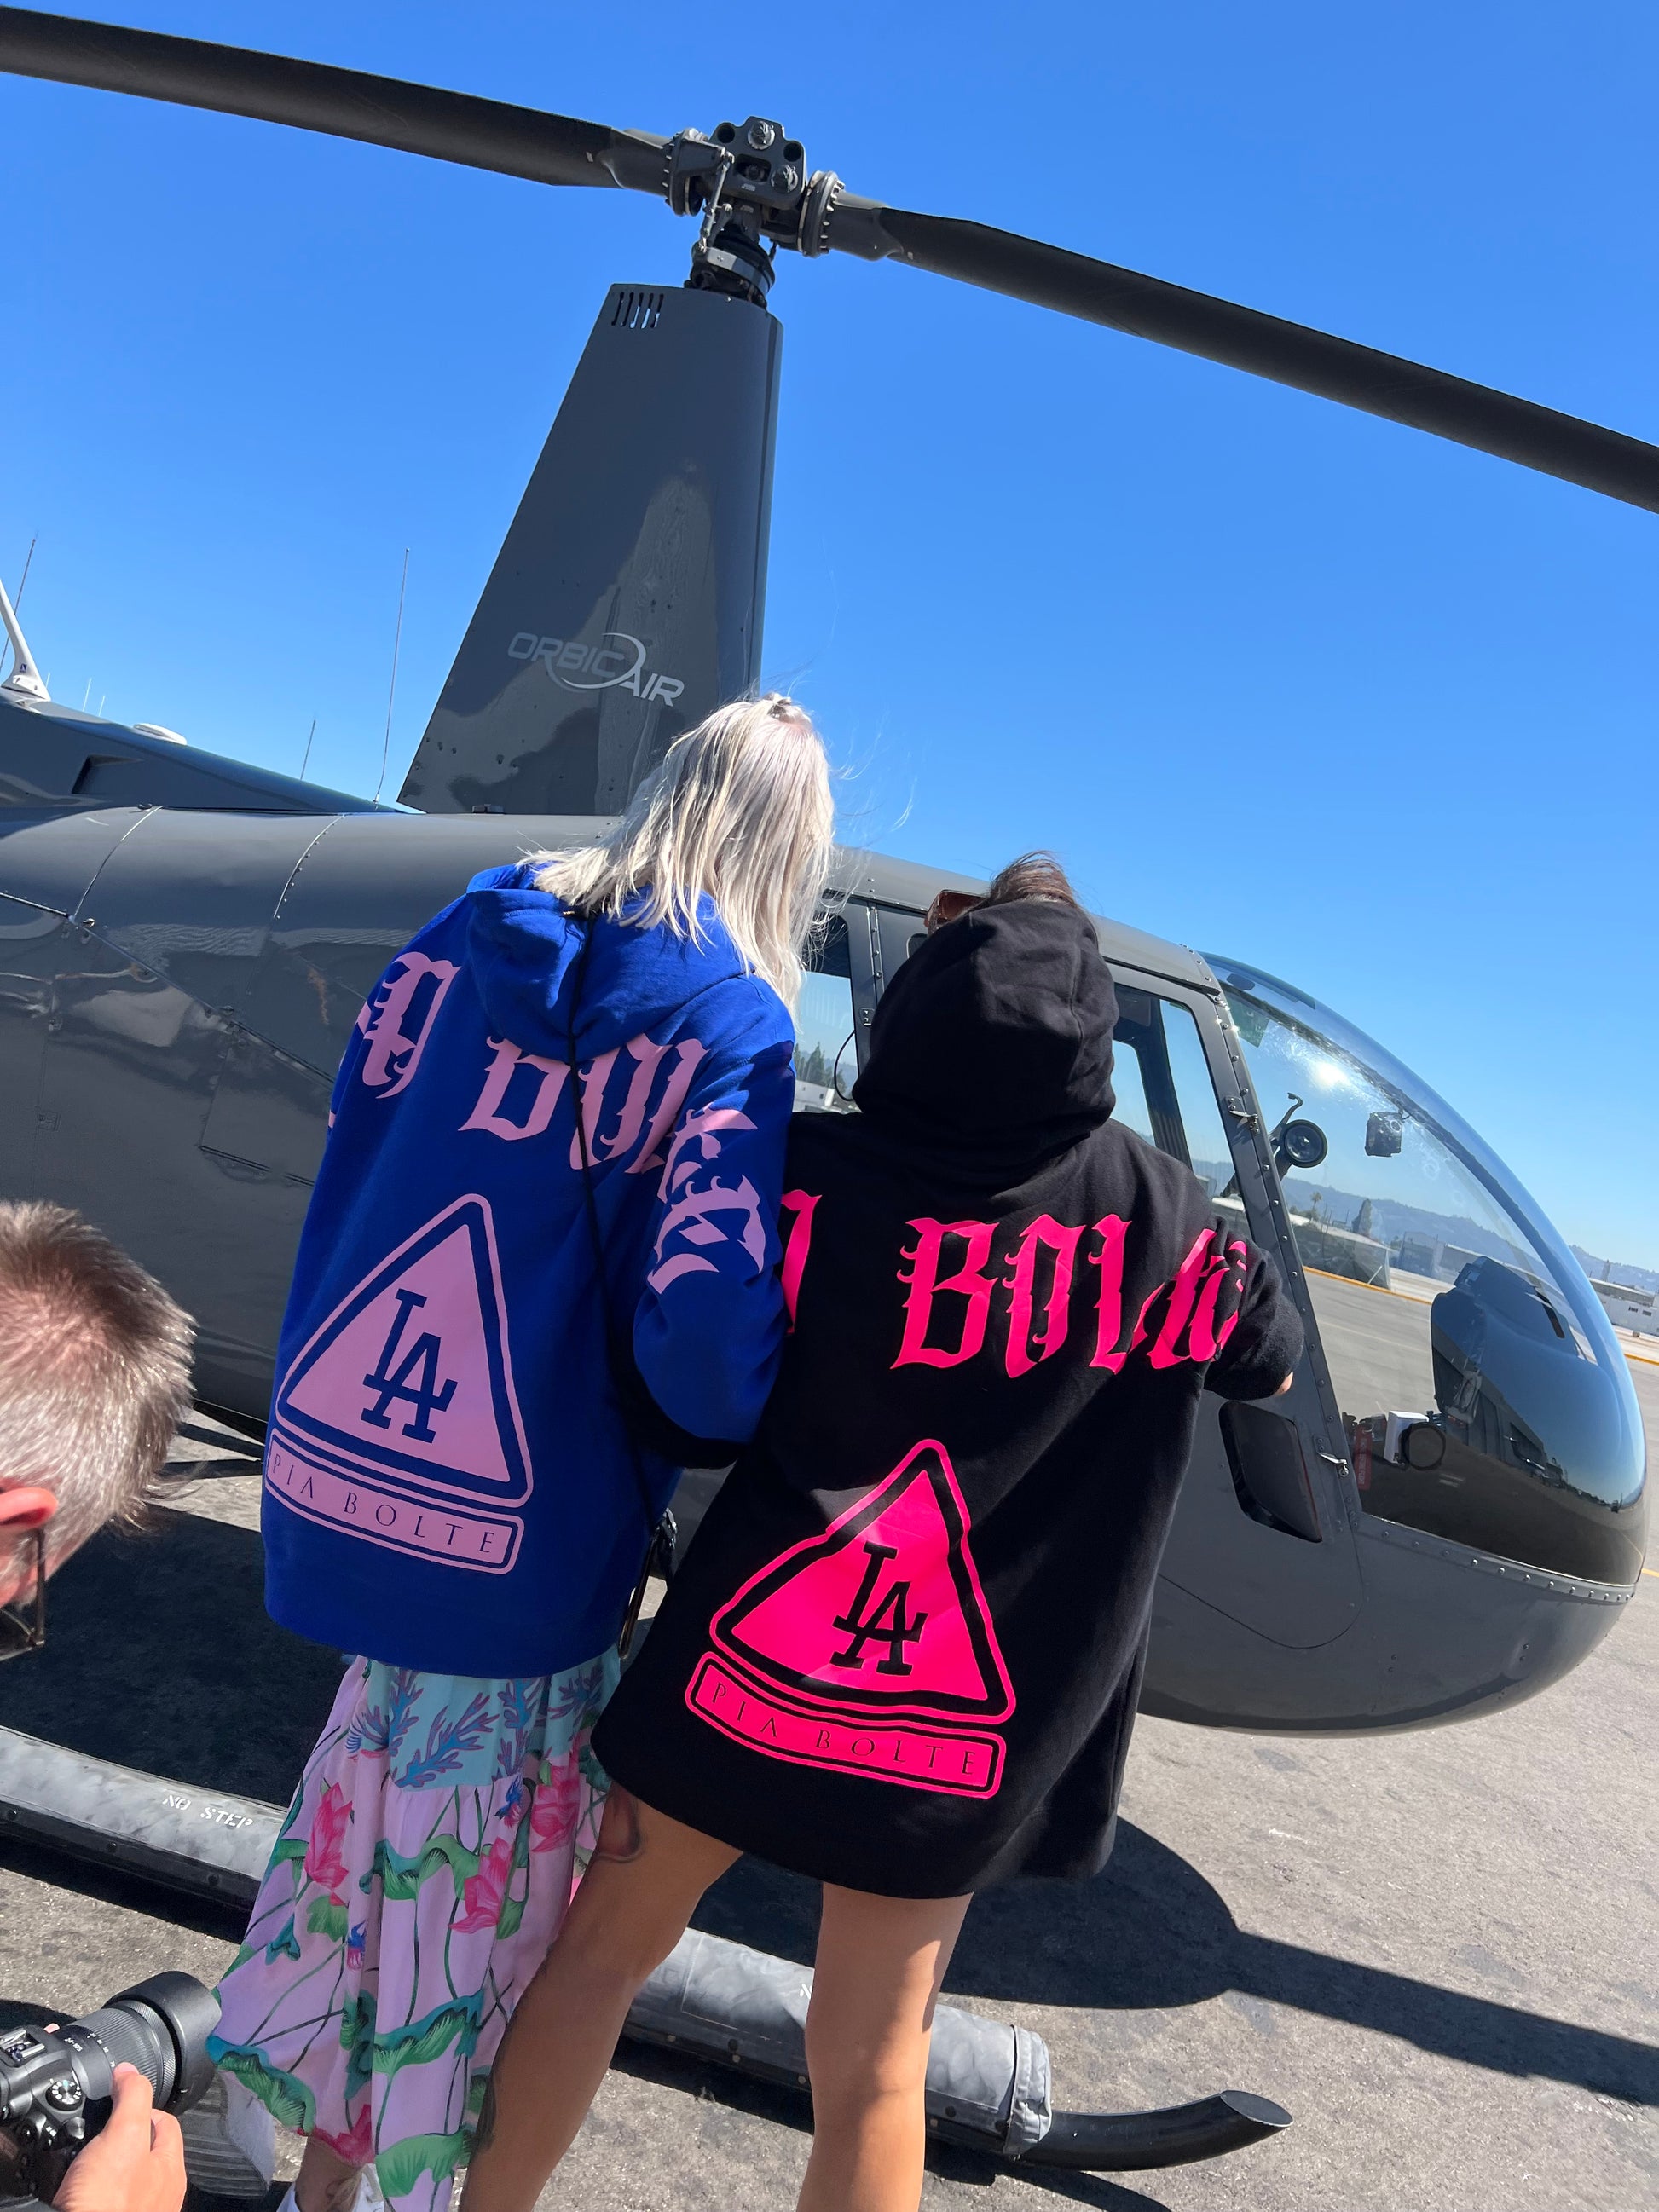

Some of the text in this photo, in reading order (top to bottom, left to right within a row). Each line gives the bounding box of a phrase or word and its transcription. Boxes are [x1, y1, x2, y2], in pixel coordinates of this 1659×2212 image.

[507, 632, 626, 679] ORBIC
[619, 665, 685, 707] AIR
[360, 1288, 459, 1444] LA
[272, 1453, 495, 1554] PIA BOLTE
[830, 1540, 928, 1677] LA
[710, 1681, 976, 1776] PIA BOLTE
[162, 1794, 254, 1828] NO STEP
